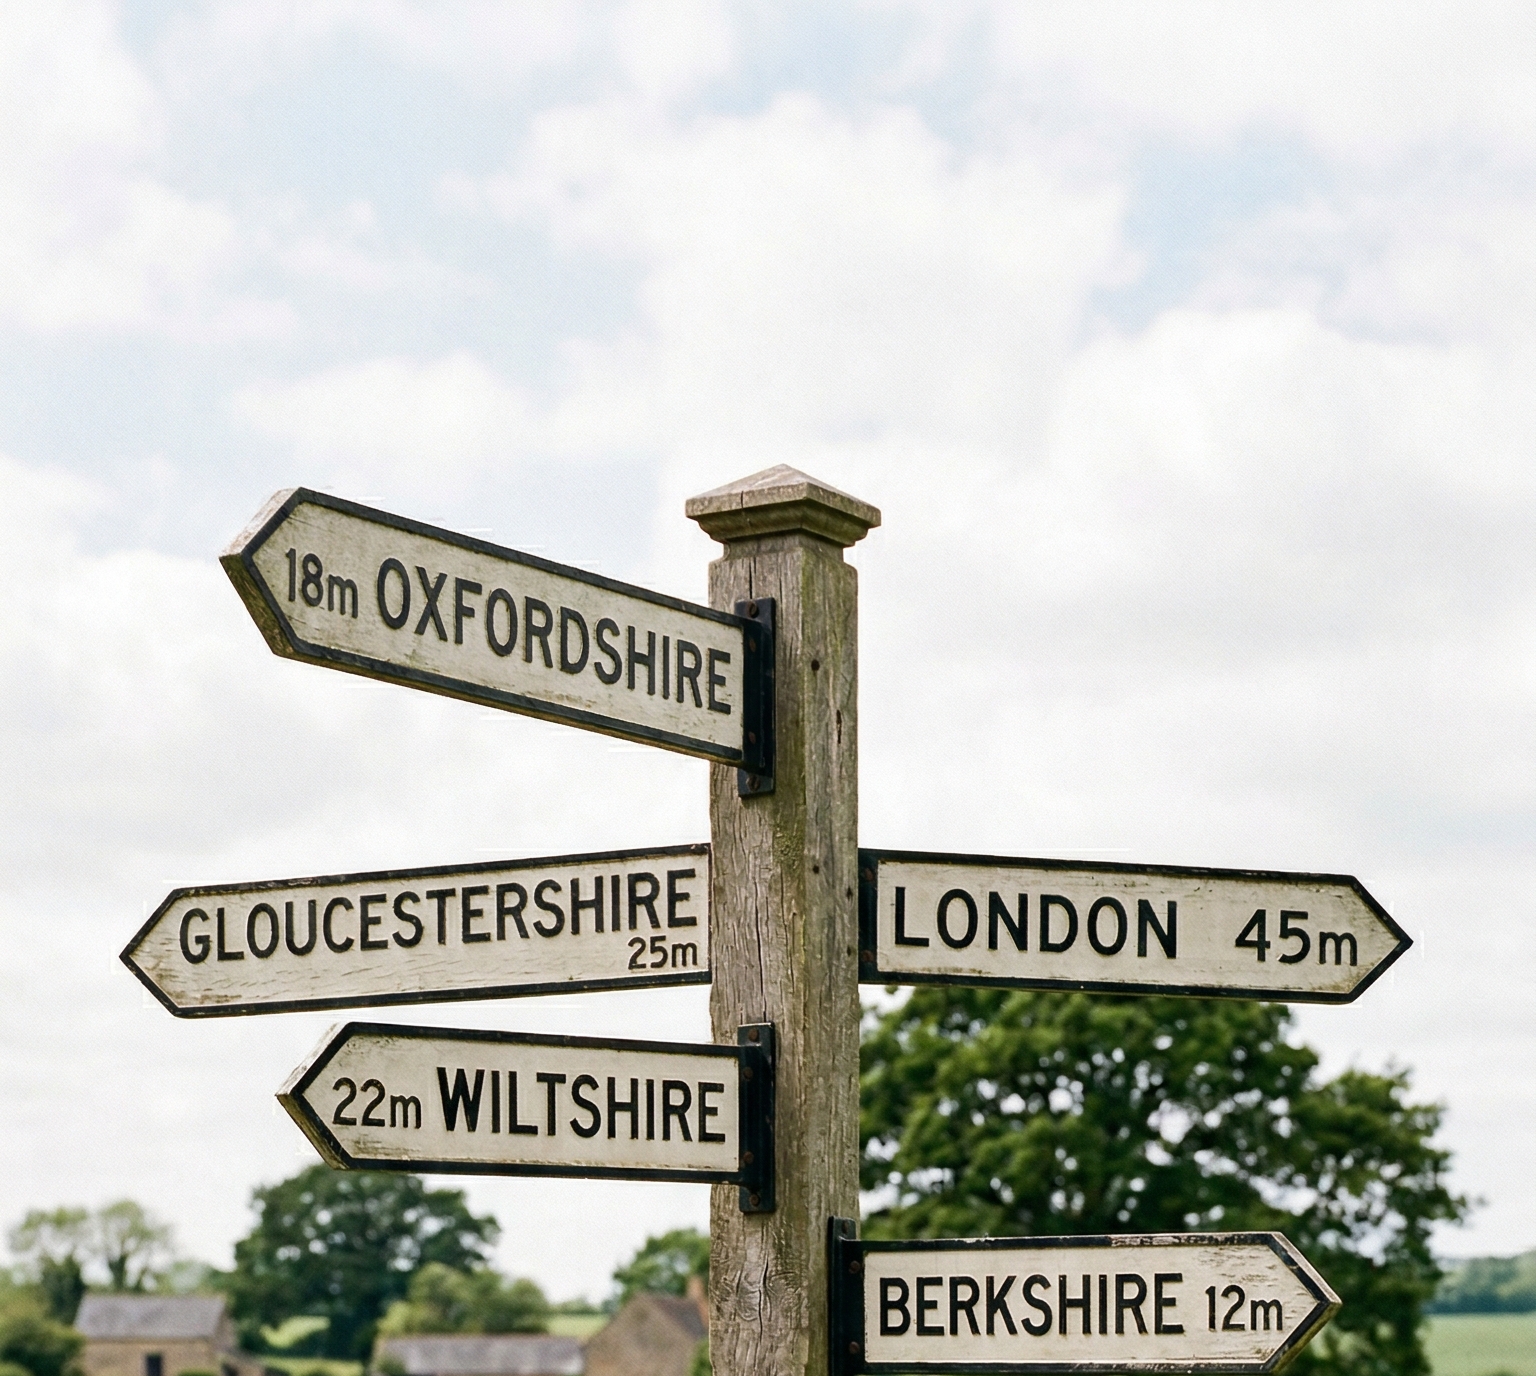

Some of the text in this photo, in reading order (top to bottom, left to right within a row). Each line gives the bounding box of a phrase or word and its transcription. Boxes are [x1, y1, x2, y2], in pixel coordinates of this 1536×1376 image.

[284, 546, 733, 715] 18m OXFORDSHIRE
[179, 867, 699, 965] GLOUCESTERSHIRE
[627, 935, 699, 971] 25m
[894, 886, 1359, 967] LONDON 45m
[331, 1066, 726, 1145] 22m WILTSHIRE
[879, 1272, 1284, 1337] BERKSHIRE 12m
